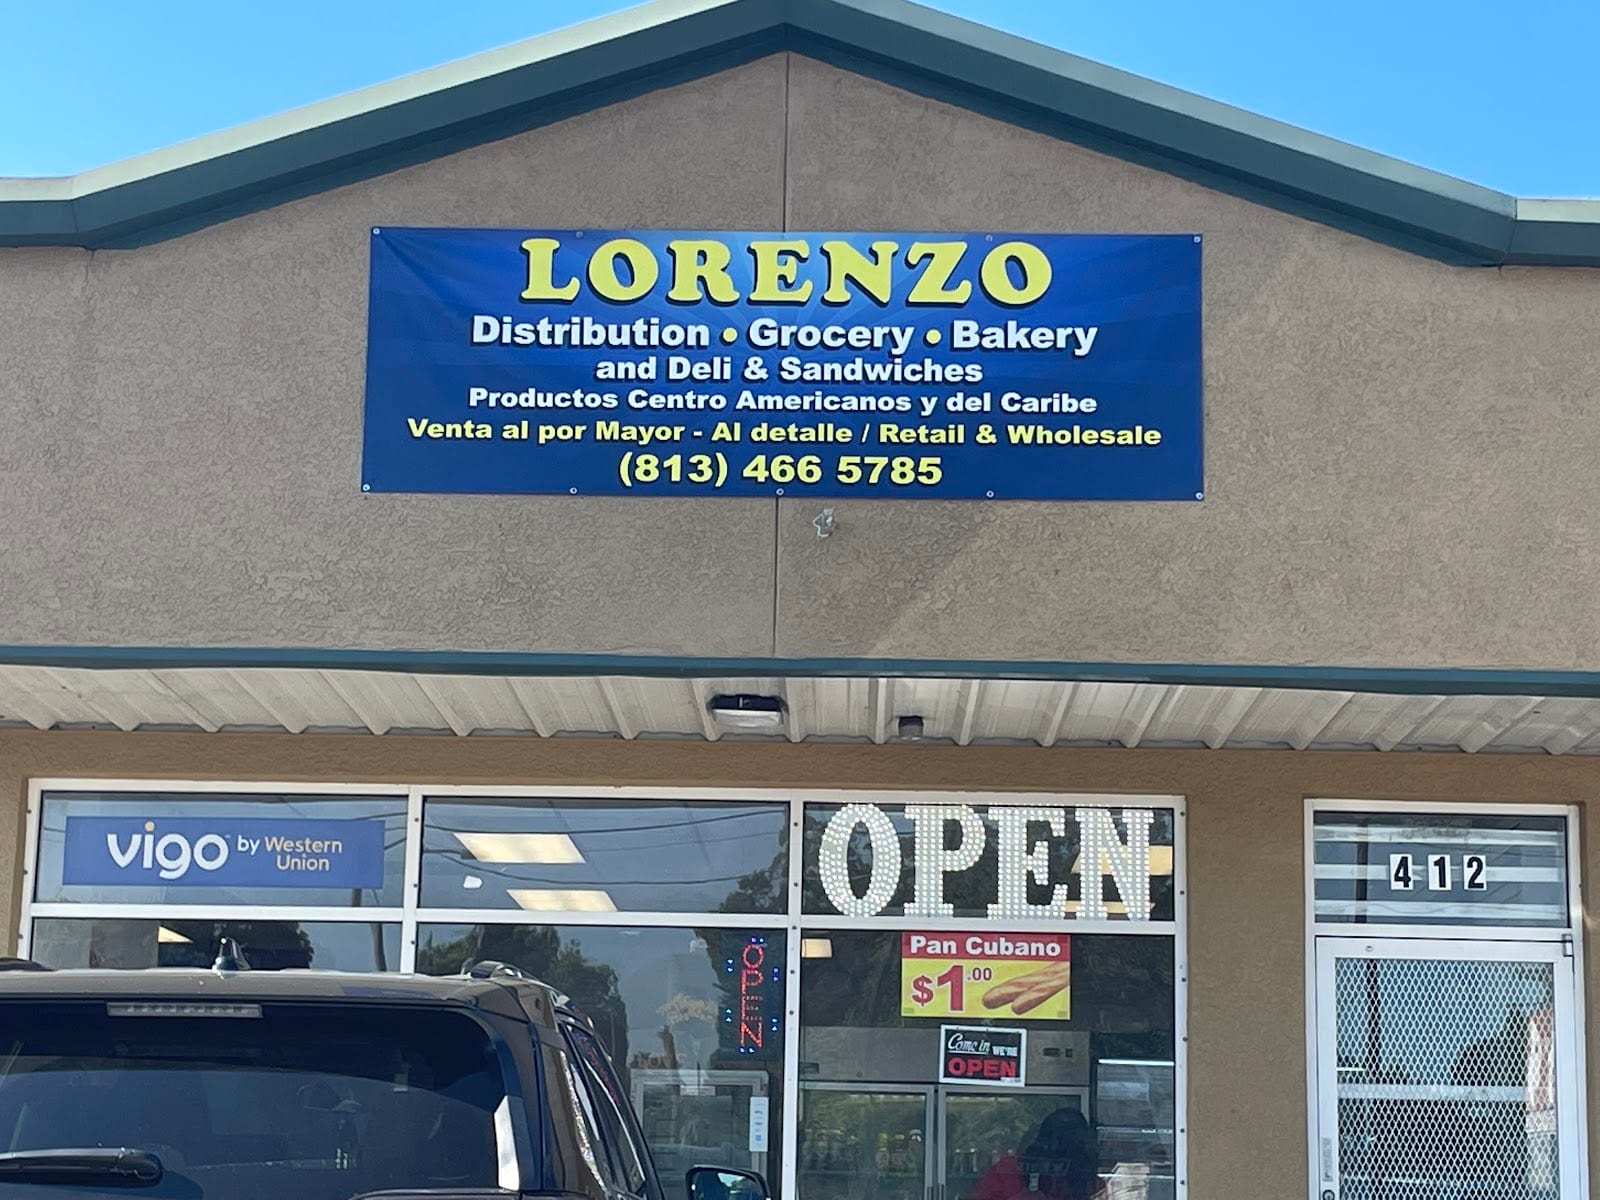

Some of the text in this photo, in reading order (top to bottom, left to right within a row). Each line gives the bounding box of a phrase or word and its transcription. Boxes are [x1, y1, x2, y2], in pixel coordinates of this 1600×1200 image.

[520, 238, 1053, 306] LORENZO
[473, 315, 1098, 356] Distribution Grocery Bakery
[596, 356, 983, 382] and Deli & Sandwiches
[469, 387, 1097, 416] Productos Centro Americanos y del Caribe
[407, 418, 492, 439] Venta
[502, 420, 529, 439] al
[538, 425, 587, 444] por
[596, 420, 686, 446] Mayor
[711, 421, 741, 442] Al
[750, 422, 853, 443] detalle
[861, 423, 870, 443] /
[879, 423, 965, 444] Retail
[975, 424, 997, 444] &
[1007, 424, 1162, 445] Wholesale
[619, 451, 943, 487] (813) 466 5785
[106, 820, 342, 880] vigo by Western
[276, 852, 330, 871] Union
[818, 802, 1155, 921] OPEN
[1394, 856, 1485, 889] 412
[910, 935, 1061, 957] Pan Cubano
[739, 943, 764, 1049] OPEN
[948, 1033, 977, 1052] Come
[948, 1057, 1017, 1077] OPEN
